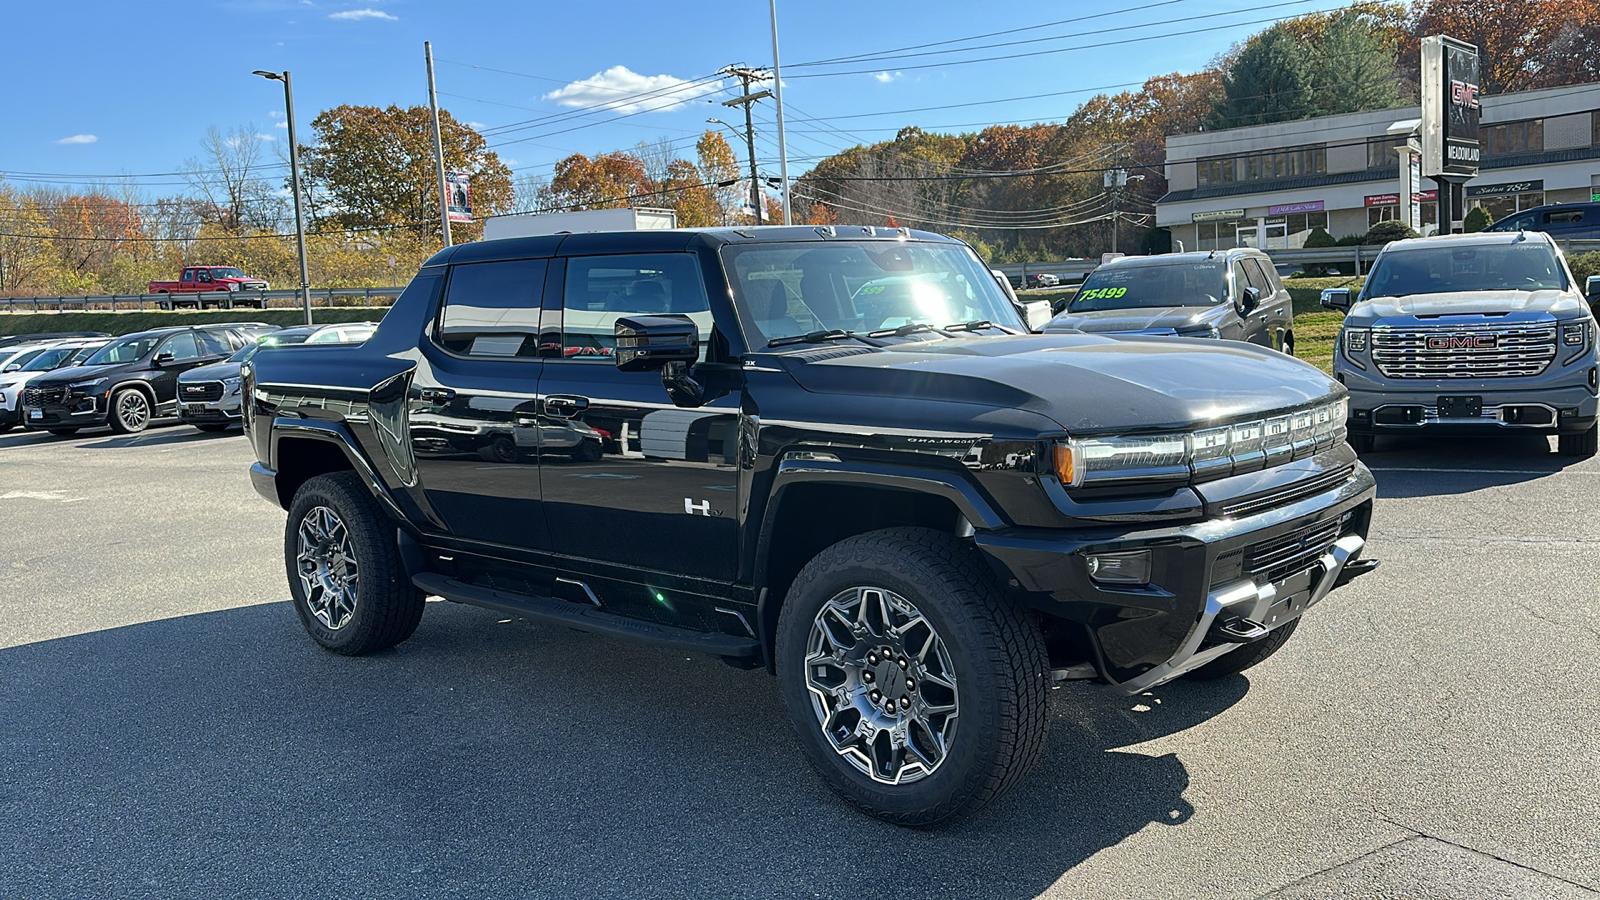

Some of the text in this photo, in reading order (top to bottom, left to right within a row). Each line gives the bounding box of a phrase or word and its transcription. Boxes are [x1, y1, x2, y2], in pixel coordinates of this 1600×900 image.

[1451, 80, 1479, 109] GMC
[1448, 145, 1480, 161] MEADOWLAND
[1476, 183, 1531, 195] Salon 782
[1079, 287, 1127, 302] 75499
[1429, 336, 1496, 348] GMC
